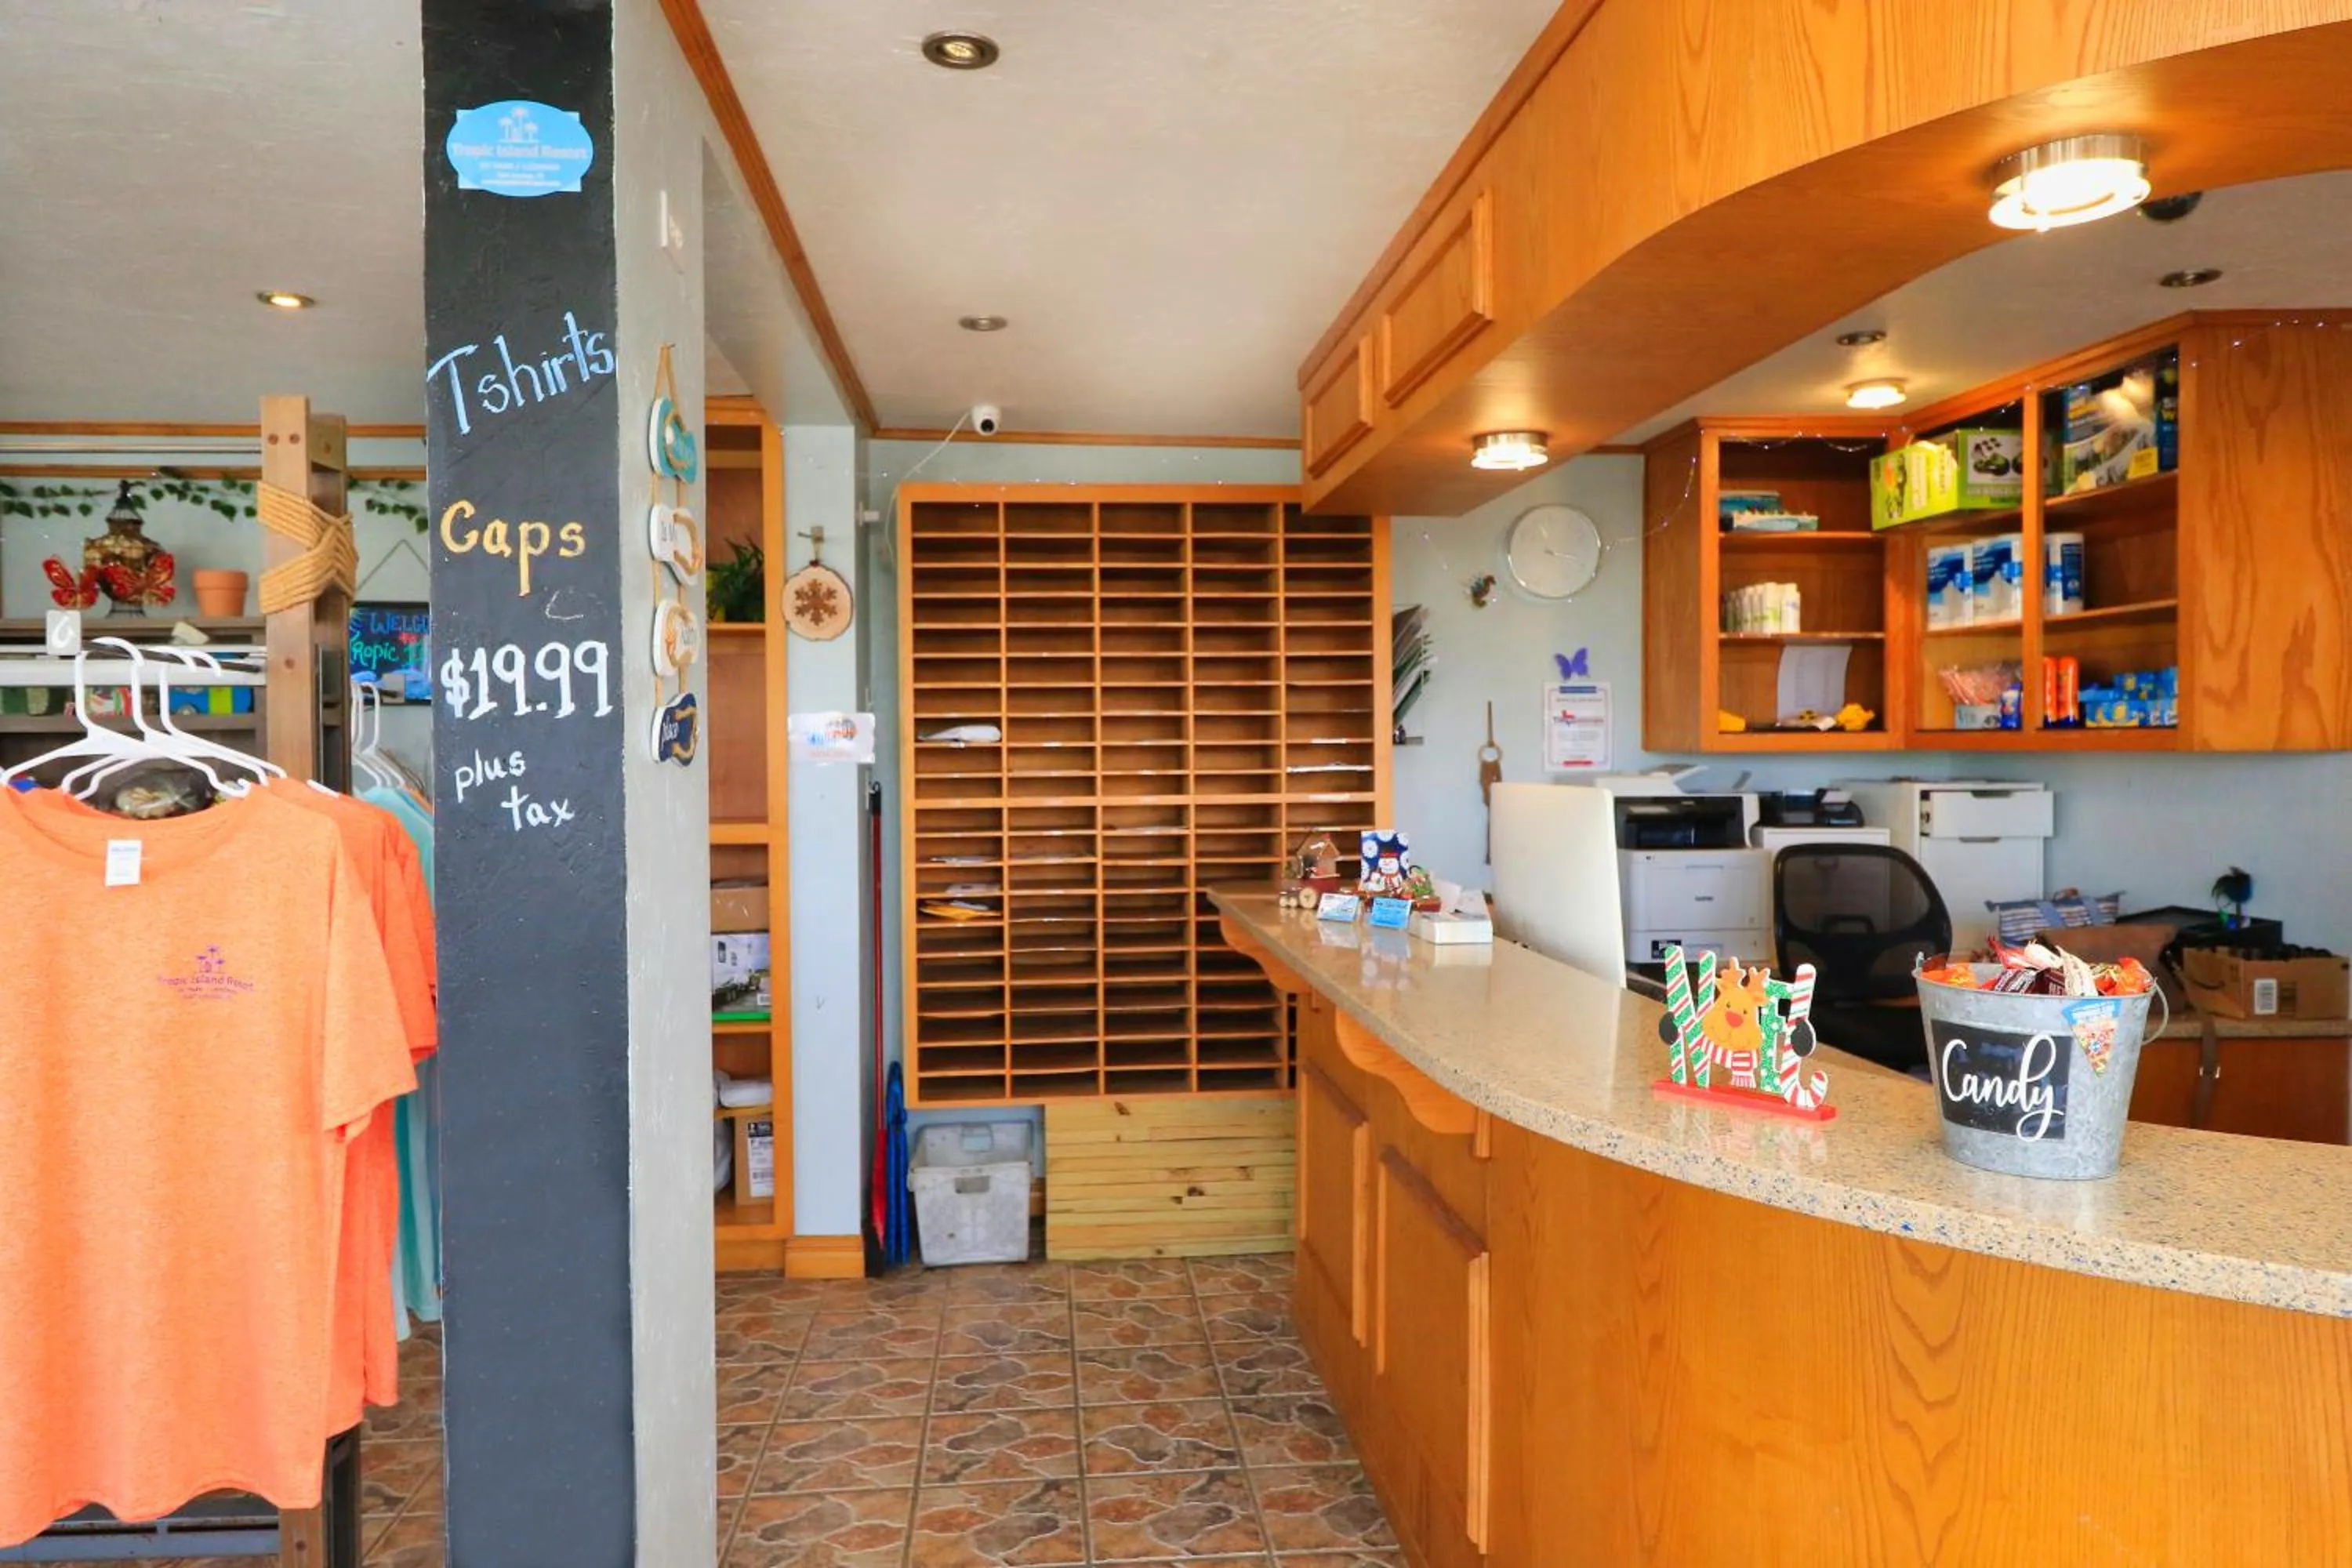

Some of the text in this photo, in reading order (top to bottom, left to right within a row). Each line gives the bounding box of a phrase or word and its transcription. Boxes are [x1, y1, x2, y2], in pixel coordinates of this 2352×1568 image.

[427, 311, 615, 435] Tshirts
[440, 500, 586, 597] Caps
[441, 641, 613, 720] $19.99
[455, 749, 526, 803] plus
[501, 786, 575, 831] tax
[1942, 1034, 2064, 1142] Candy
